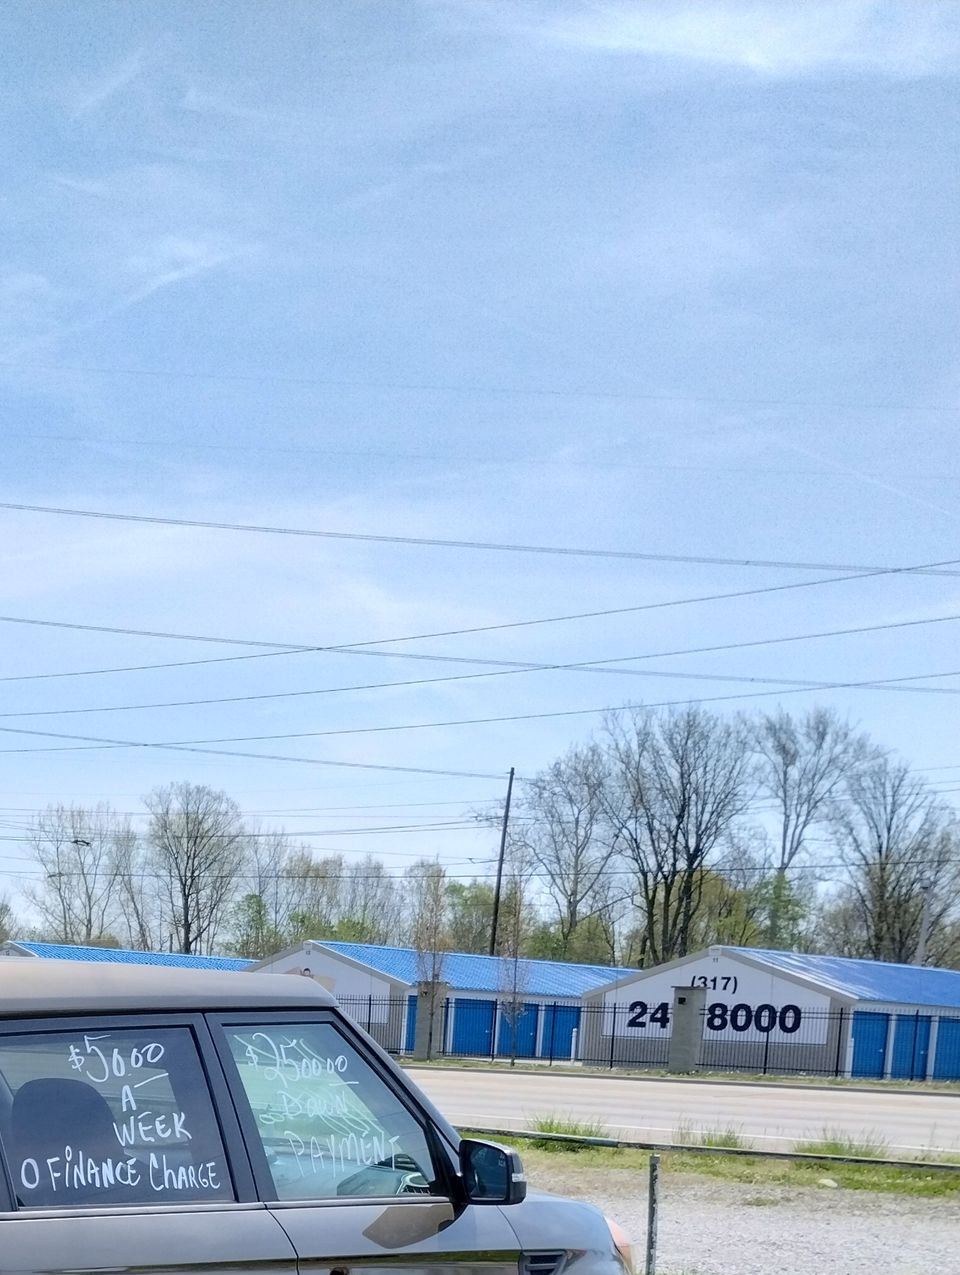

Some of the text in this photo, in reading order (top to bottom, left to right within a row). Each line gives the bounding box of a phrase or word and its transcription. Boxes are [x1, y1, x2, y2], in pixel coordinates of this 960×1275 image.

[691, 975, 738, 994] (317)
[706, 1003, 802, 1034] 8000
[121, 1085, 137, 1112] A
[112, 1111, 192, 1146] WEEK
